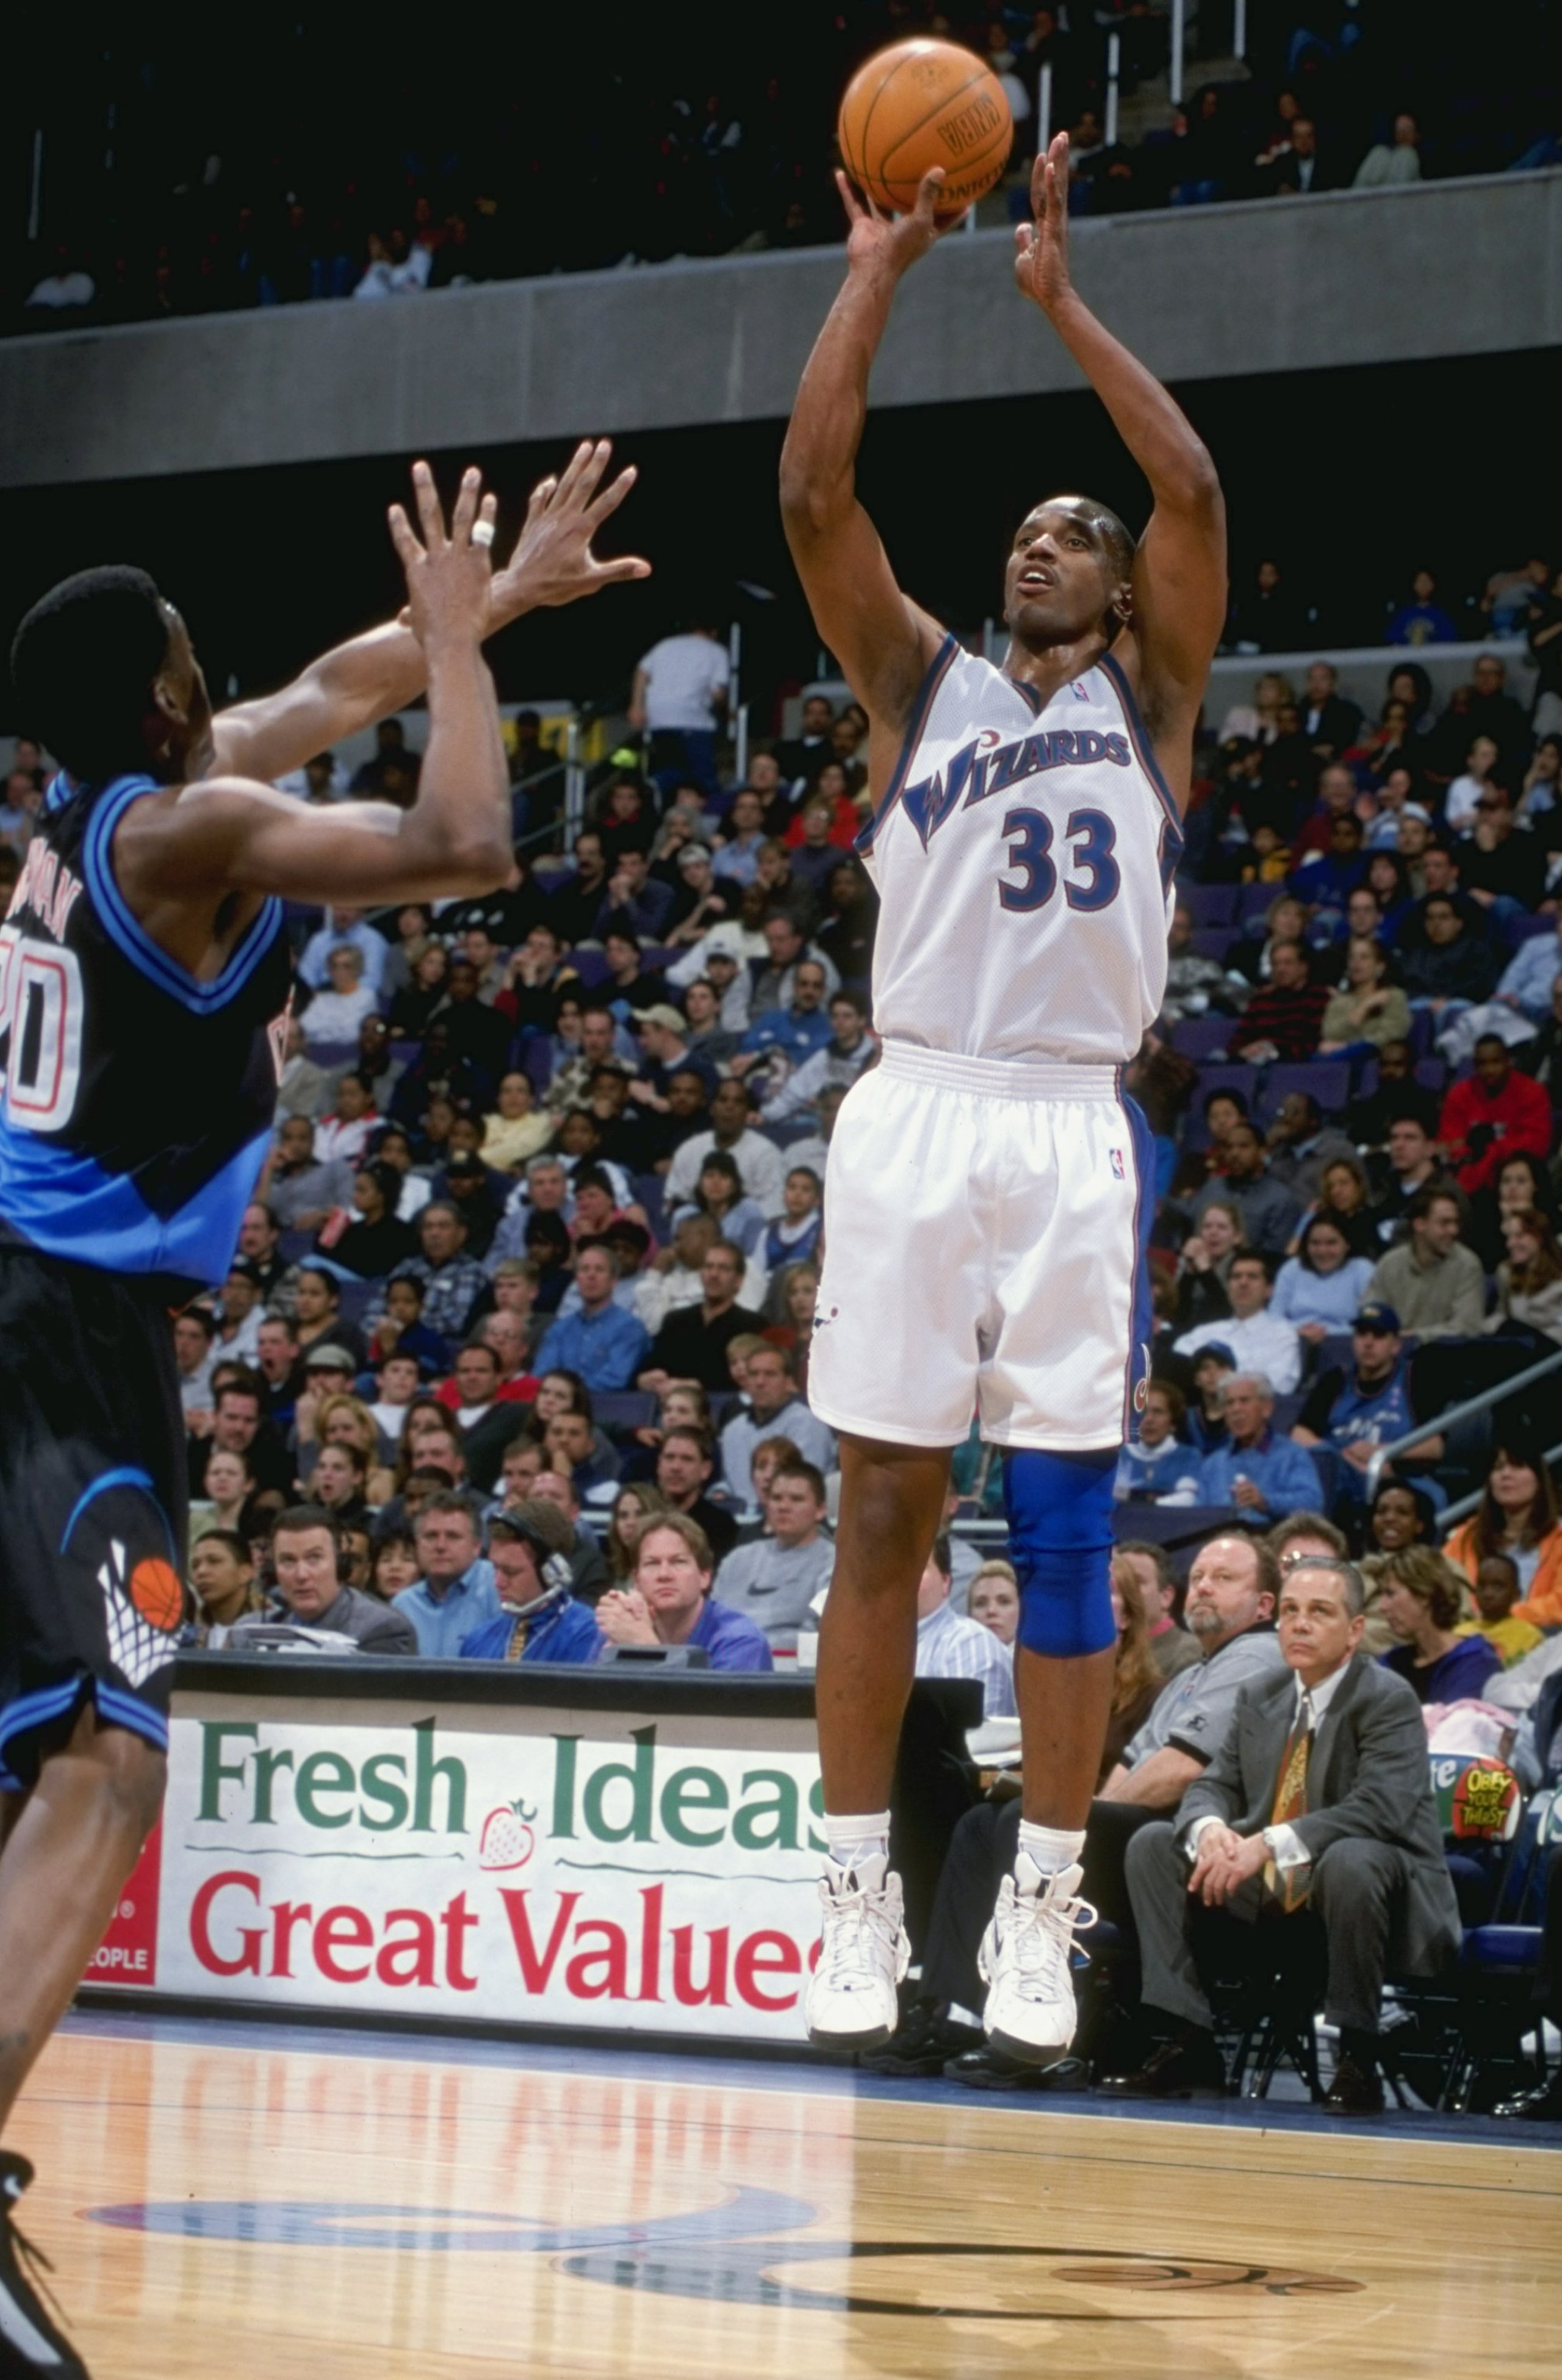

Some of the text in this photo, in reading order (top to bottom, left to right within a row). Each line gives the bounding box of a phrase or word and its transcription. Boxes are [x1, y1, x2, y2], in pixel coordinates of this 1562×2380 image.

[998, 807, 1121, 913] 33
[194, 1715, 469, 1833] Fresh
[189, 1870, 479, 1992] Great
